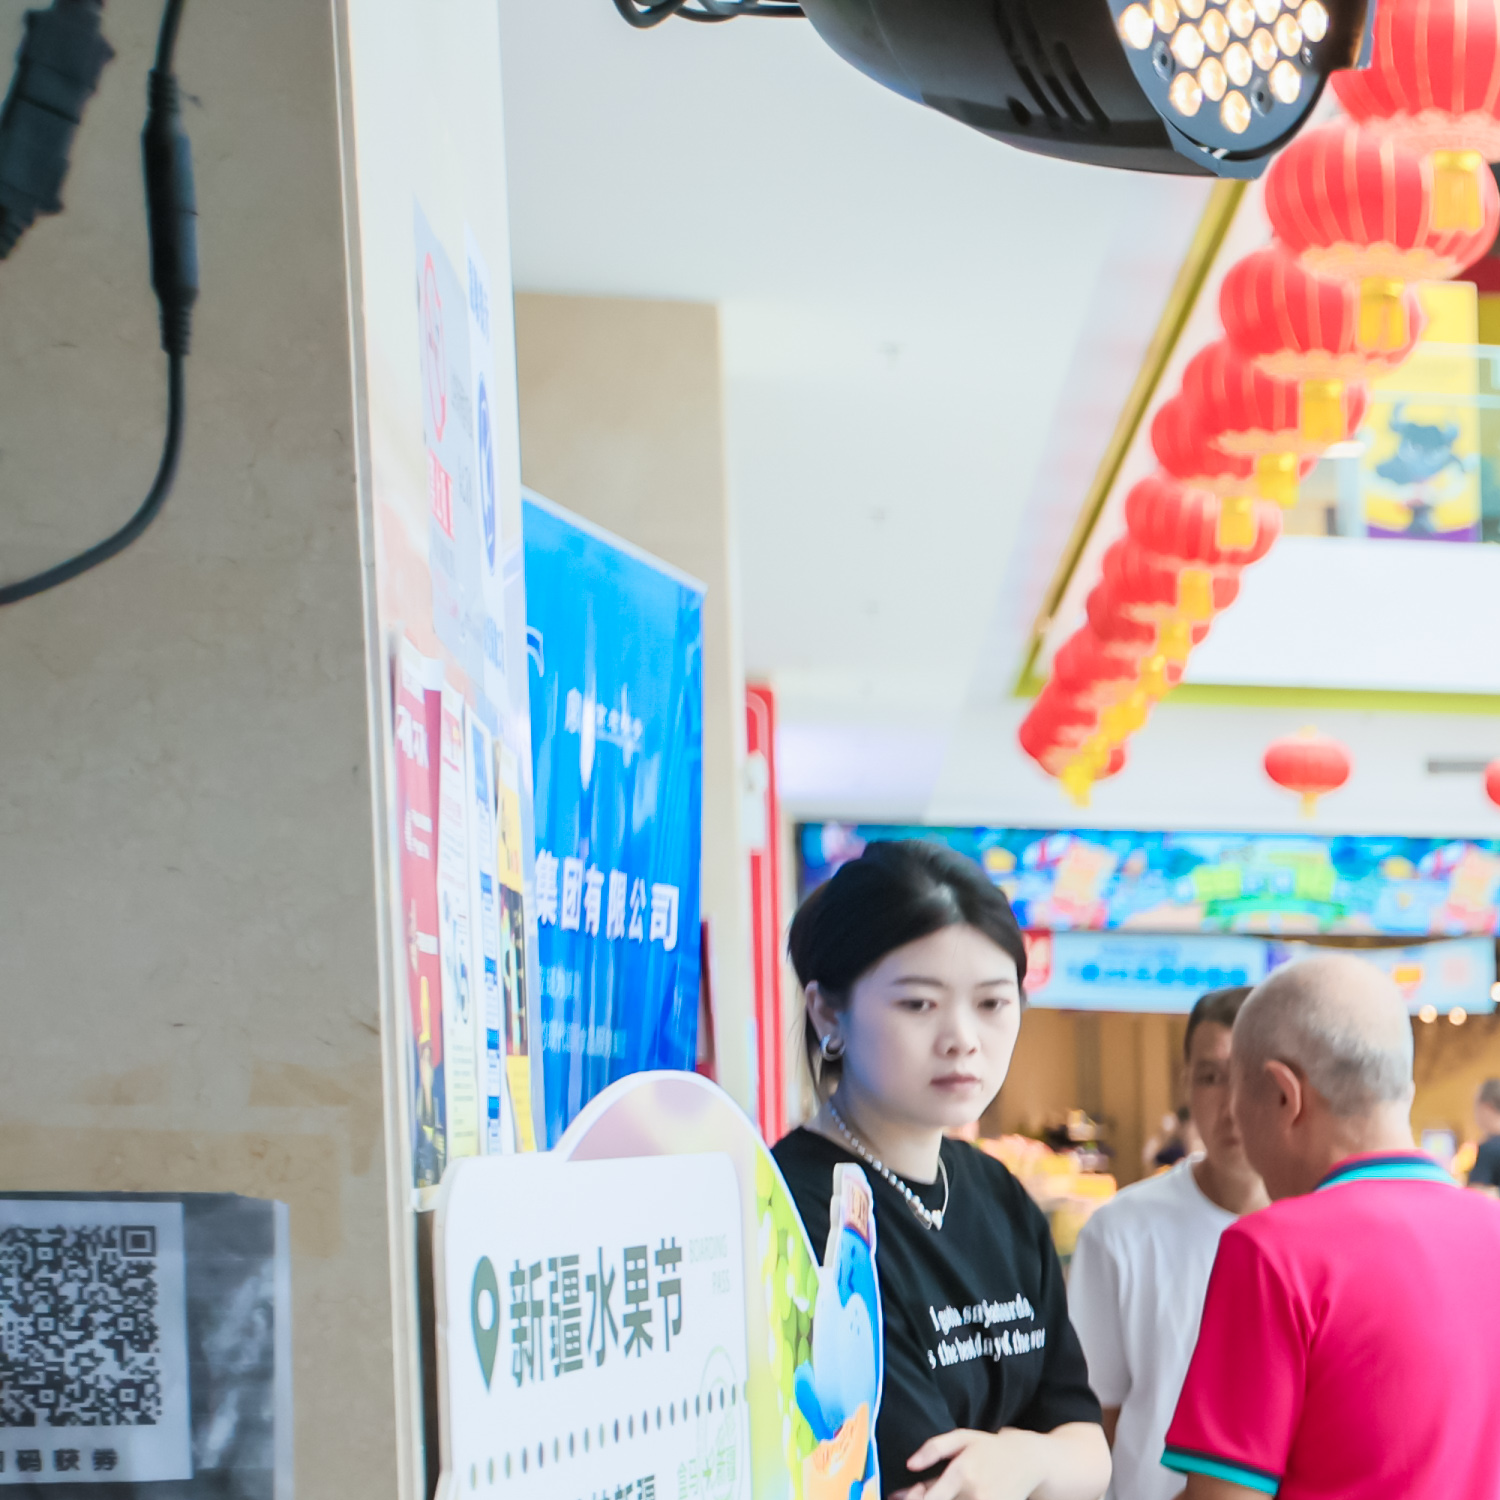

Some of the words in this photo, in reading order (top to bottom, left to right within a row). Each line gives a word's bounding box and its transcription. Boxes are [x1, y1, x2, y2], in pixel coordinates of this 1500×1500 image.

[535, 848, 680, 952] 集团有限公司
[689, 1233, 728, 1264] BOARDING
[509, 1236, 683, 1388] 新疆水果节
